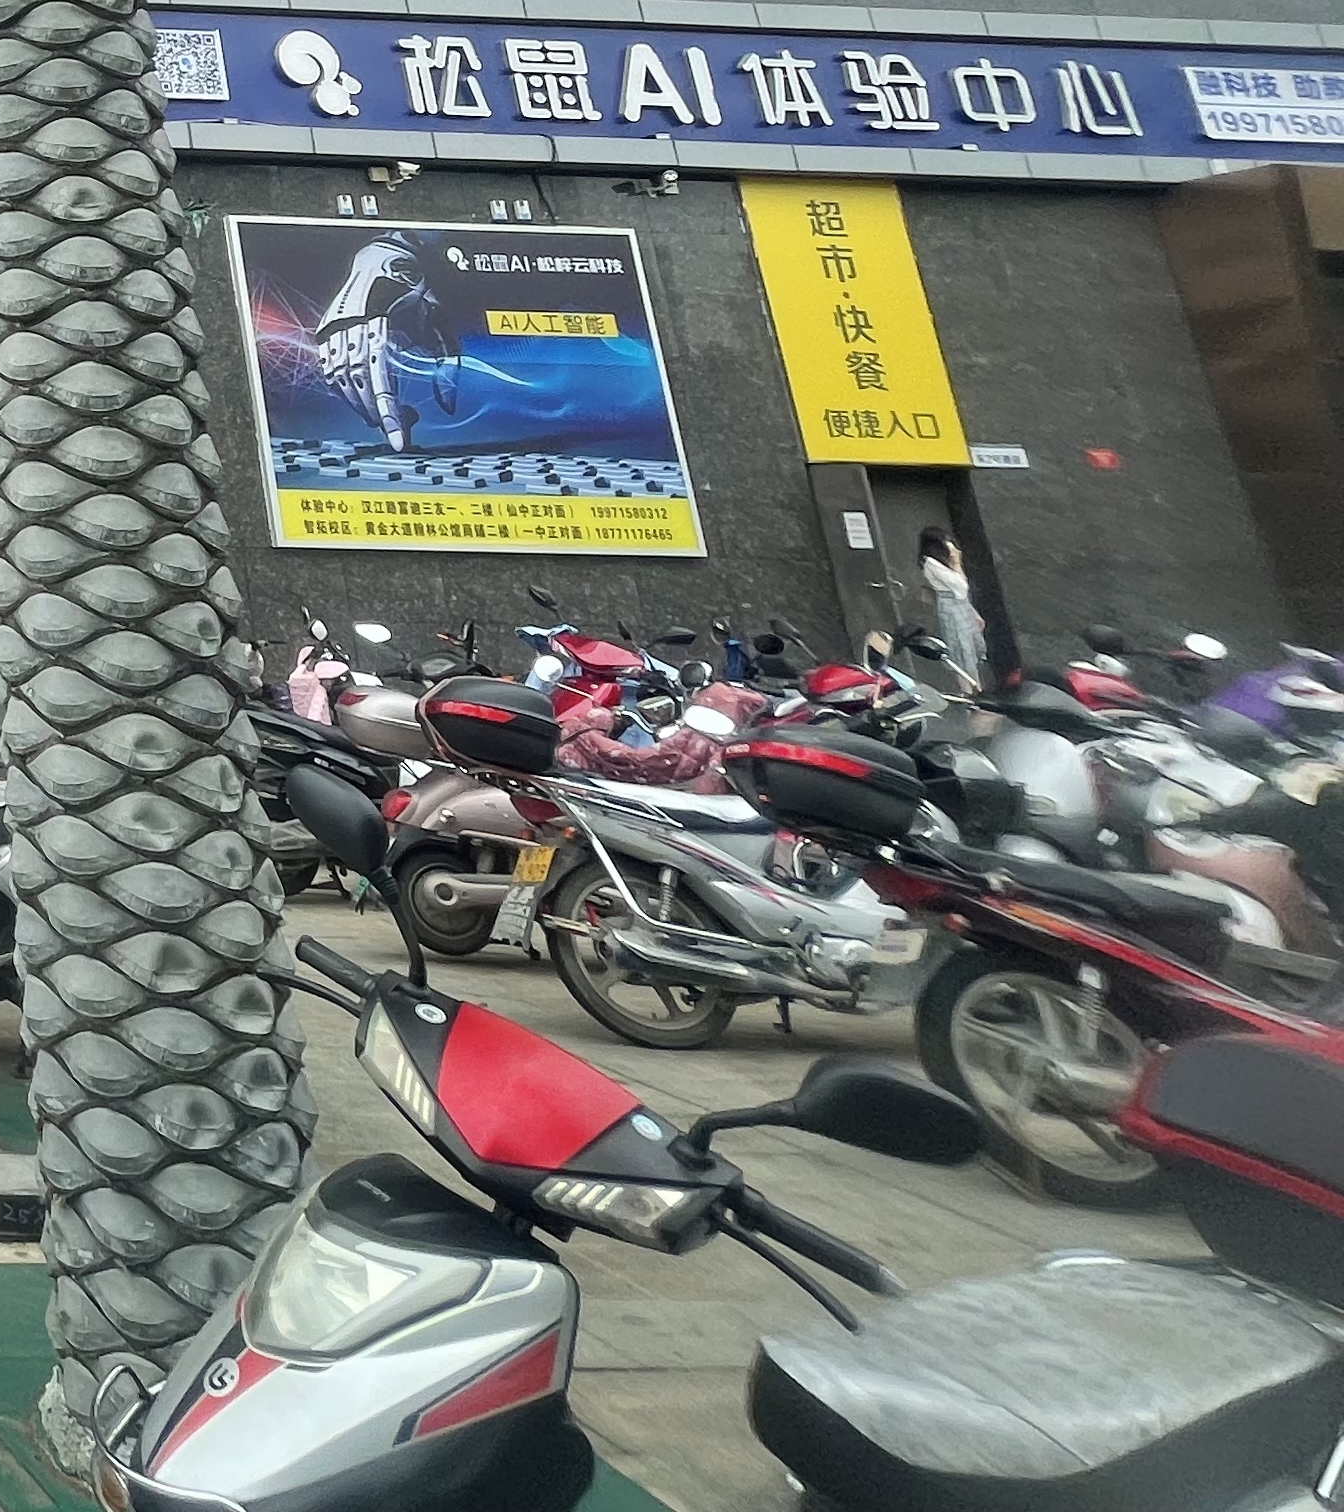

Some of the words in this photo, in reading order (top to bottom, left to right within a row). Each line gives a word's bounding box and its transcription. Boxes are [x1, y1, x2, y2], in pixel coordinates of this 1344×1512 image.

[396, 34, 1144, 138] 松鼠AI体验中心
[500, 313, 607, 335] AI人工智能
[823, 409, 941, 439] 便捷入口
